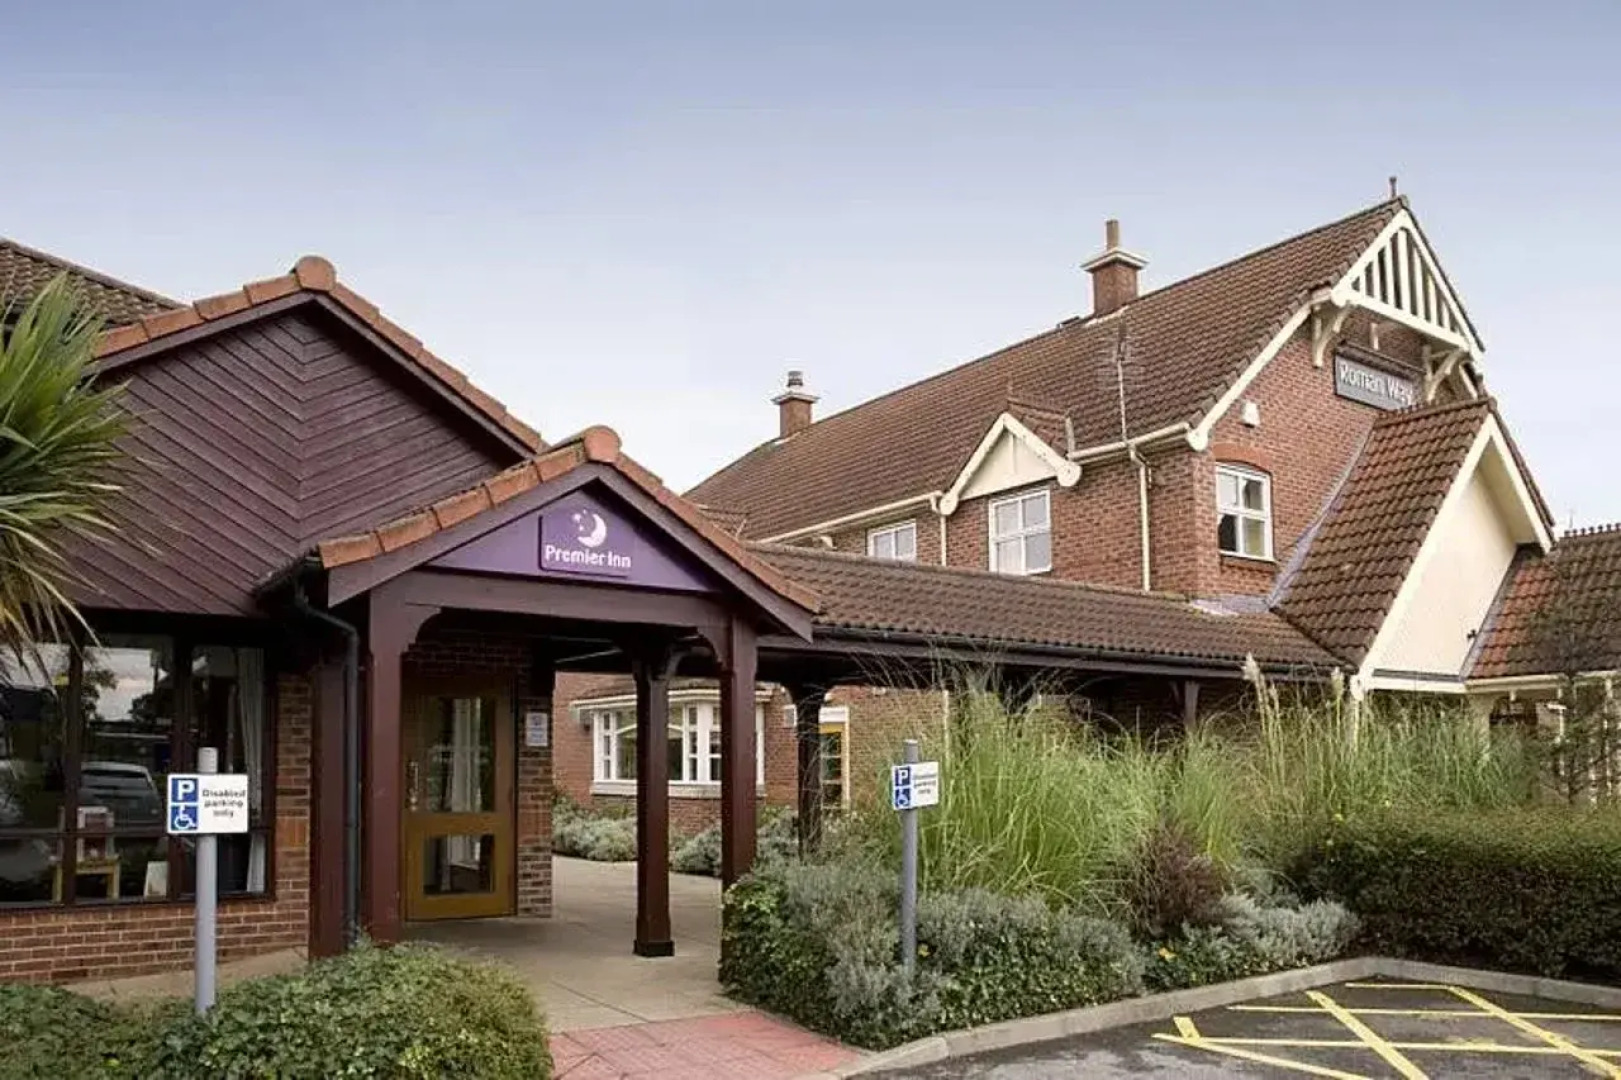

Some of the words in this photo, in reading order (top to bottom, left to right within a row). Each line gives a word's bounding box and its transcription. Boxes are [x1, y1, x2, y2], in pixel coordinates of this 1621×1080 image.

[1340, 360, 1385, 395] Roman
[545, 544, 605, 566] Premier
[608, 550, 632, 568] Inn
[898, 769, 909, 785] P
[177, 780, 195, 800] P
[202, 789, 246, 797] Disabled
[204, 800, 244, 808] parking
